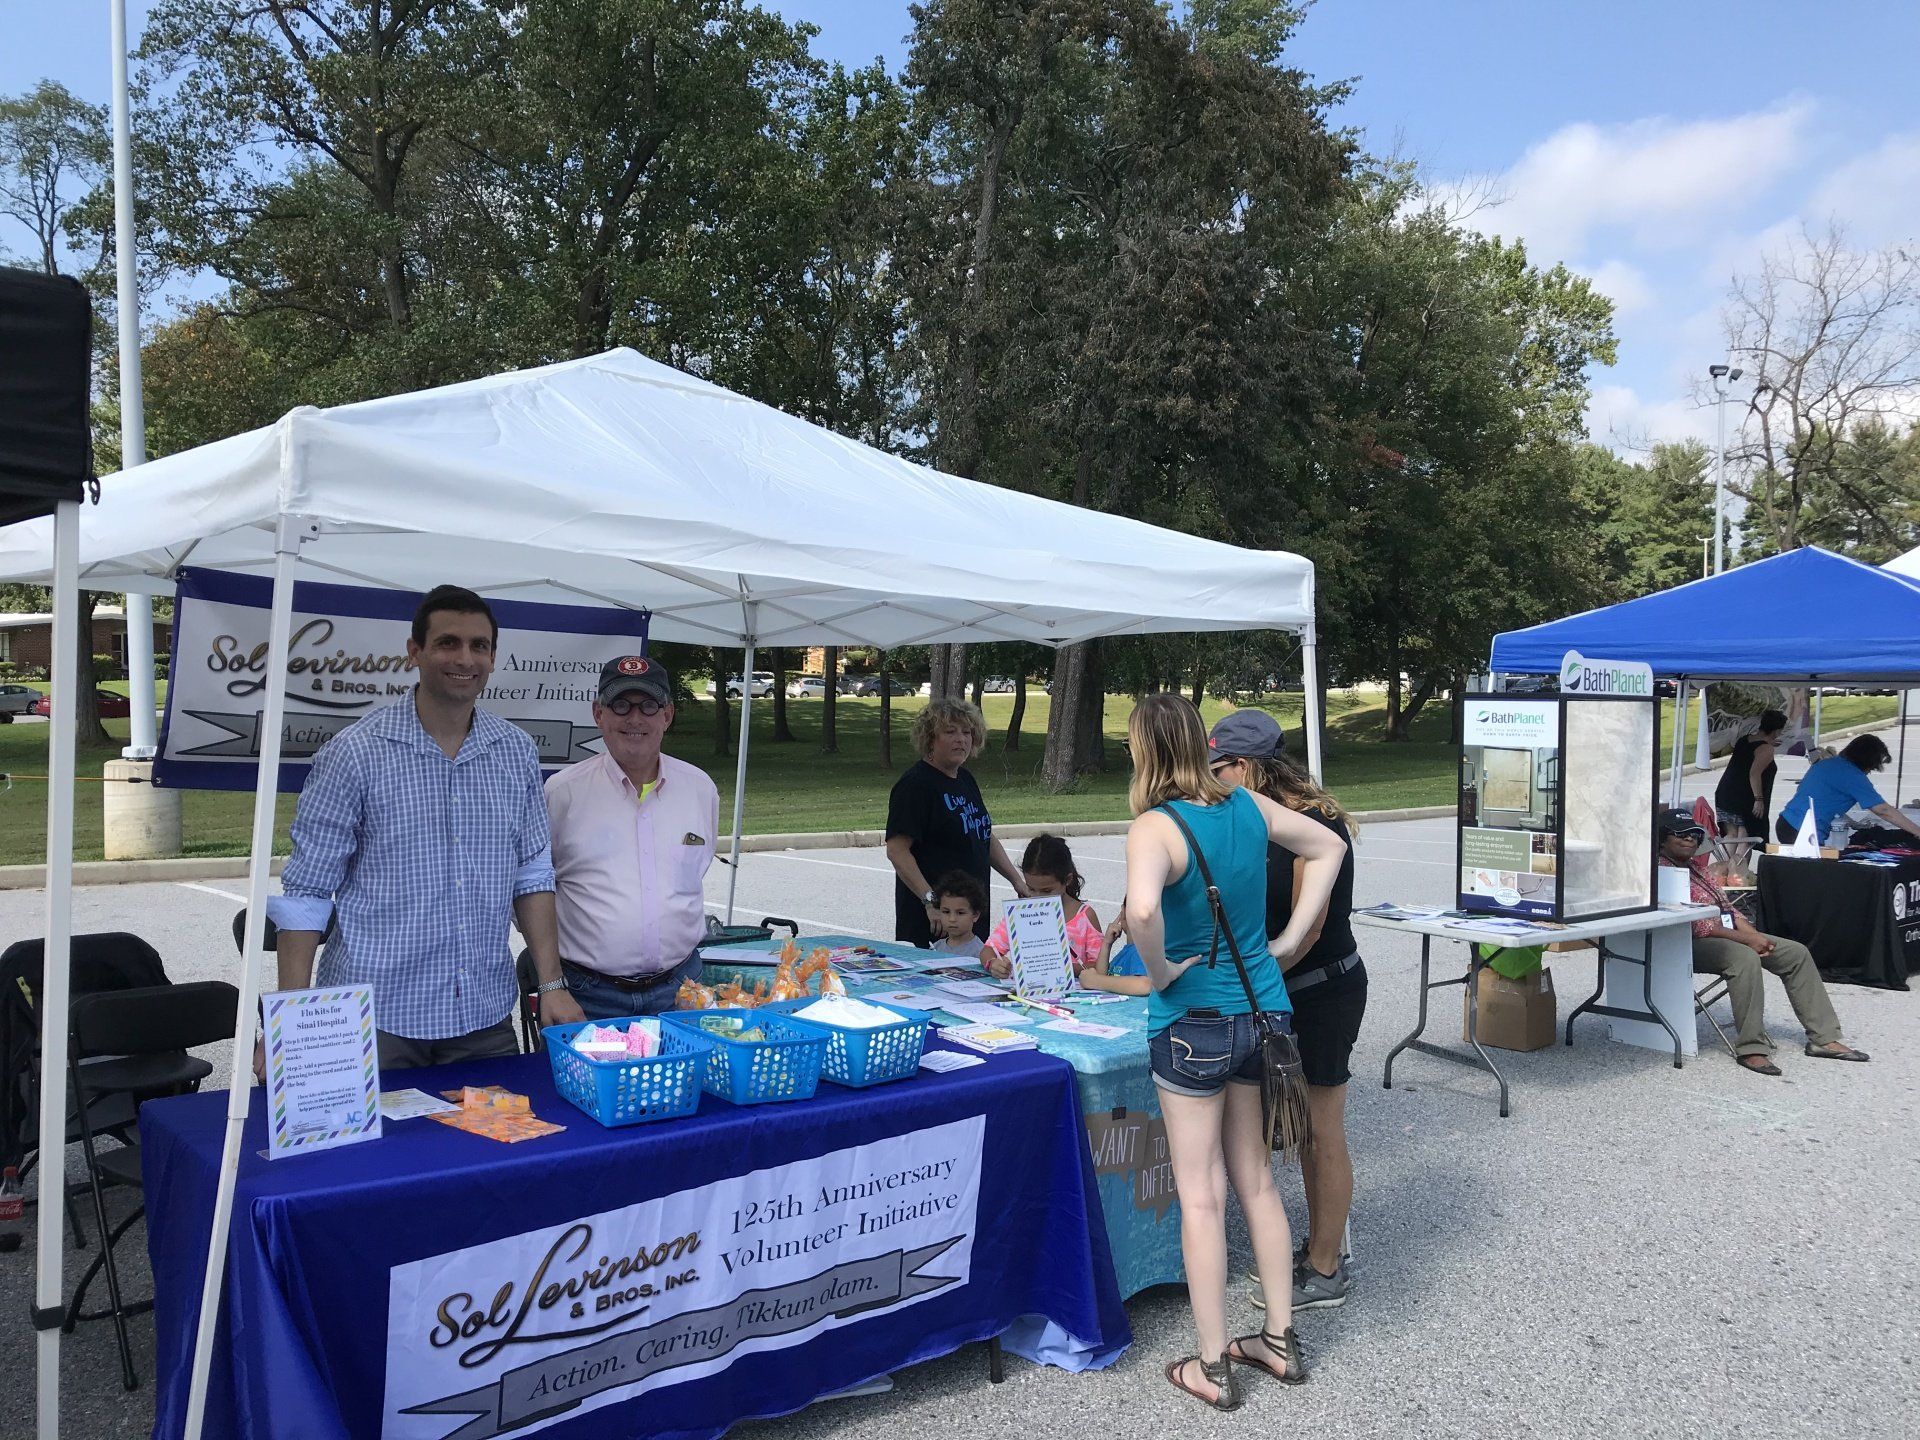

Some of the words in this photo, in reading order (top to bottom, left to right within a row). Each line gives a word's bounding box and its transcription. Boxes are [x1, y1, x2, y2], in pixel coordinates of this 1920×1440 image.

[502, 653, 606, 674] Anniversar
[311, 678, 323, 692] &
[1583, 667, 1647, 694] BathPlanet
[535, 683, 599, 702] Initiati
[1491, 712, 1545, 724] BathPlanet
[281, 724, 334, 744] Actio
[944, 793, 966, 811] Live
[301, 1008, 314, 1018] Flu
[314, 1008, 330, 1016] Kits
[330, 1005, 342, 1014] for
[296, 1020, 316, 1030] Sinai
[317, 1016, 348, 1028] Hospital
[1087, 1126, 1141, 1168] WANT
[1153, 1136, 1166, 1160] TO
[1142, 1163, 1178, 1201] DIFFE
[731, 1194, 804, 1236] 125th
[812, 1158, 958, 1213] Anniversary
[718, 1223, 849, 1275] Volunteer
[857, 1192, 958, 1236] Initiative
[459, 1223, 703, 1369] Levinson
[429, 1281, 514, 1348] Sol
[570, 1301, 584, 1319] &
[528, 1356, 627, 1402] Action.
[636, 1323, 730, 1365] Caring.
[737, 1297, 817, 1330] Tikkun
[819, 1273, 880, 1306] olam.
